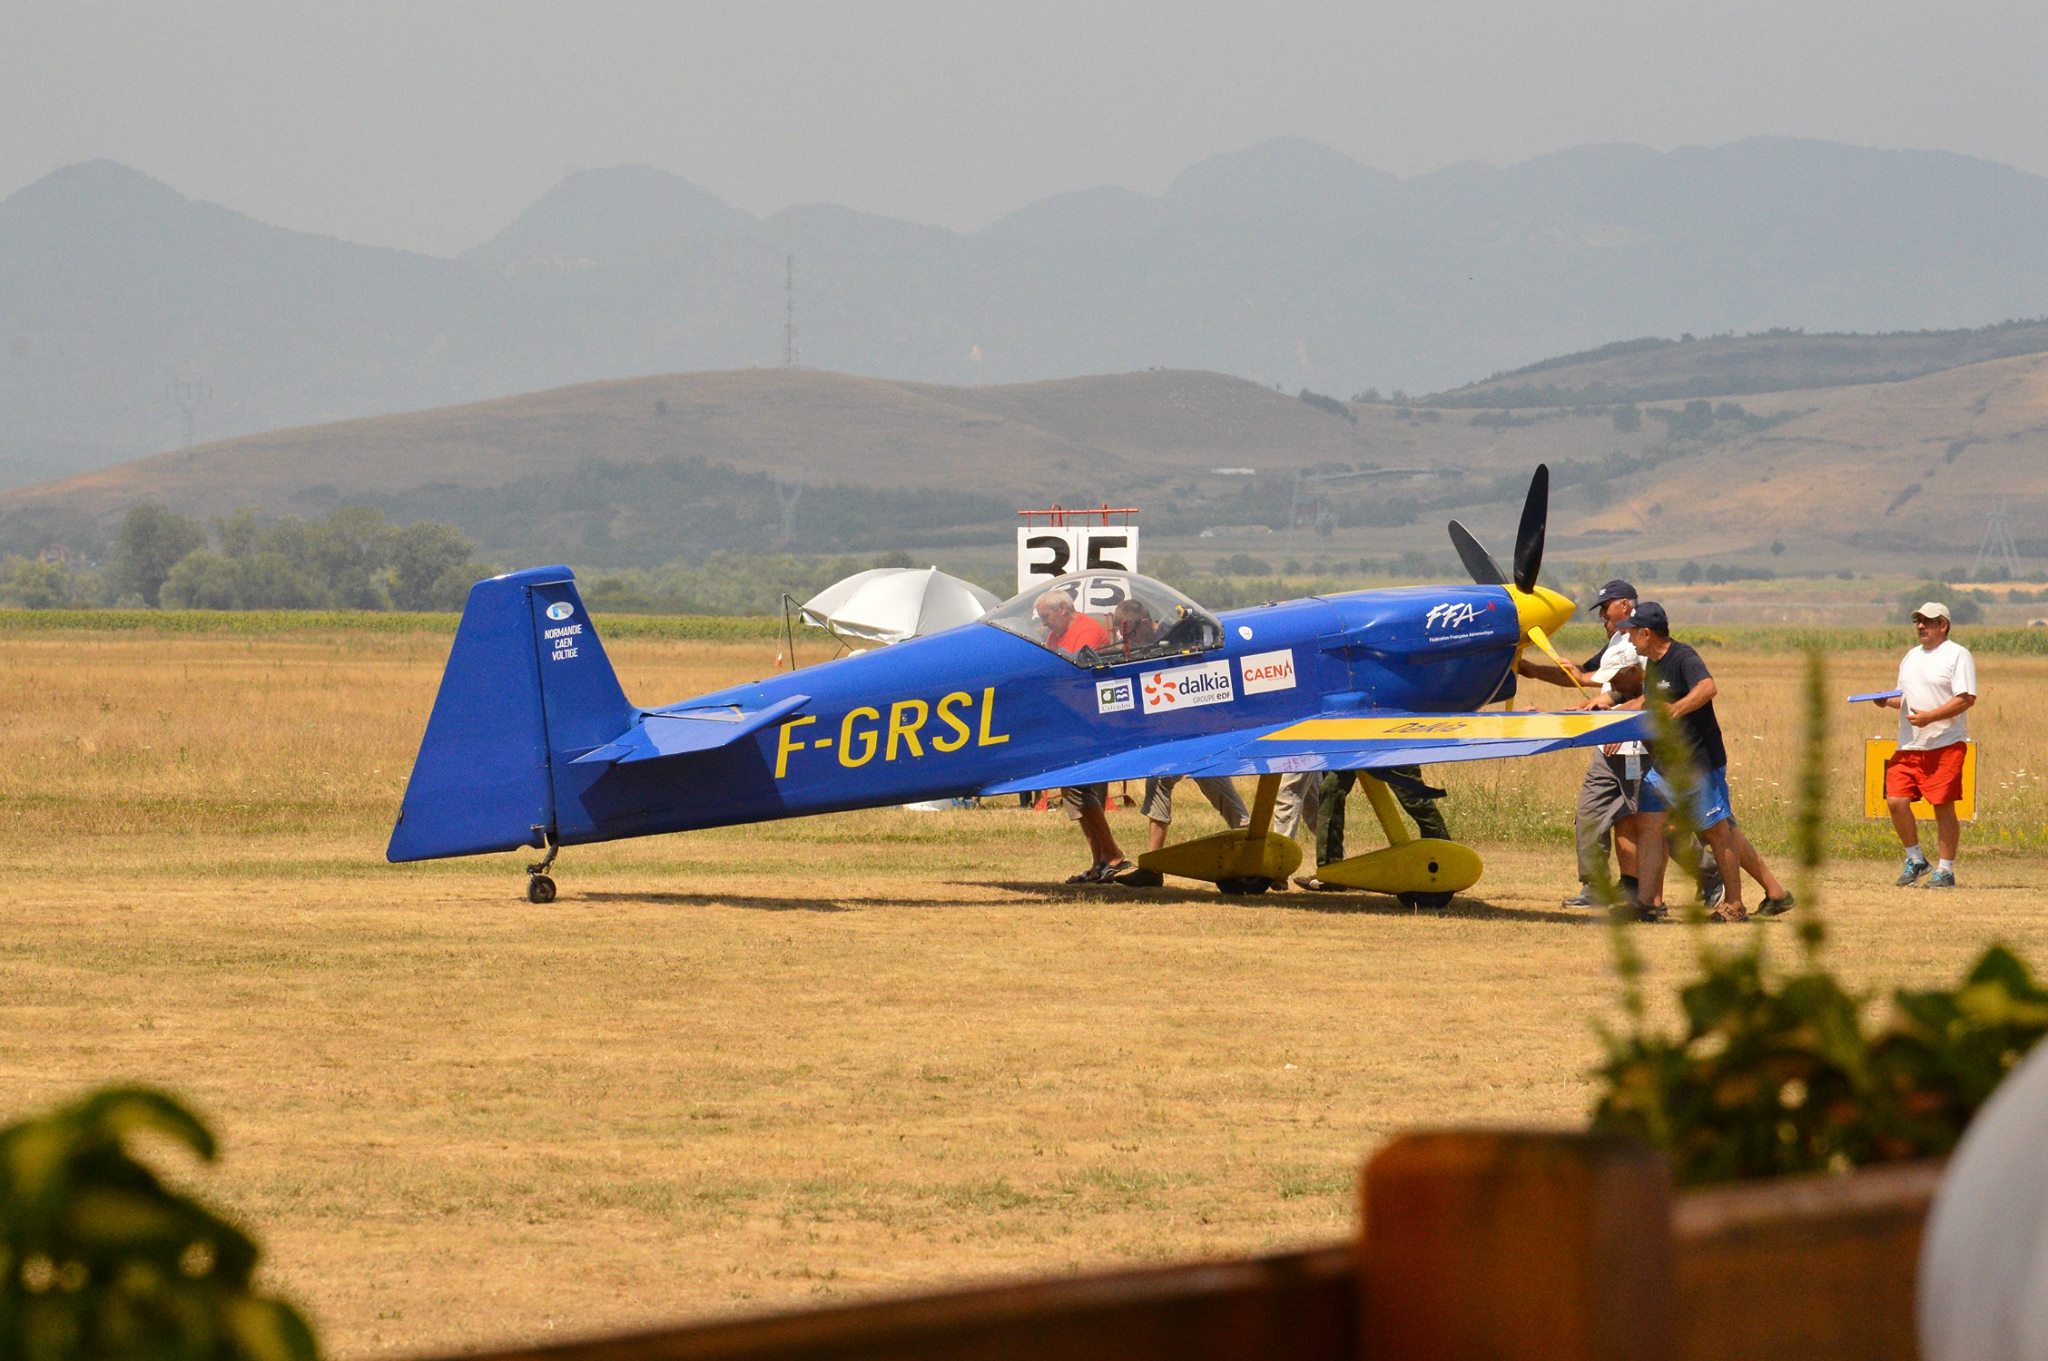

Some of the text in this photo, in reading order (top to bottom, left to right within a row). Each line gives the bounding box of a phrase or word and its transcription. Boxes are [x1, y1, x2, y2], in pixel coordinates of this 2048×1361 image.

[1426, 603, 1487, 629] FFA
[544, 624, 583, 640] NORMANDIE
[554, 637, 573, 649] CAEN
[552, 648, 579, 661] VOLTIGE
[1178, 672, 1230, 695] dalkia
[1192, 694, 1216, 704] GROUPE
[774, 686, 1010, 779] F-GRSL
